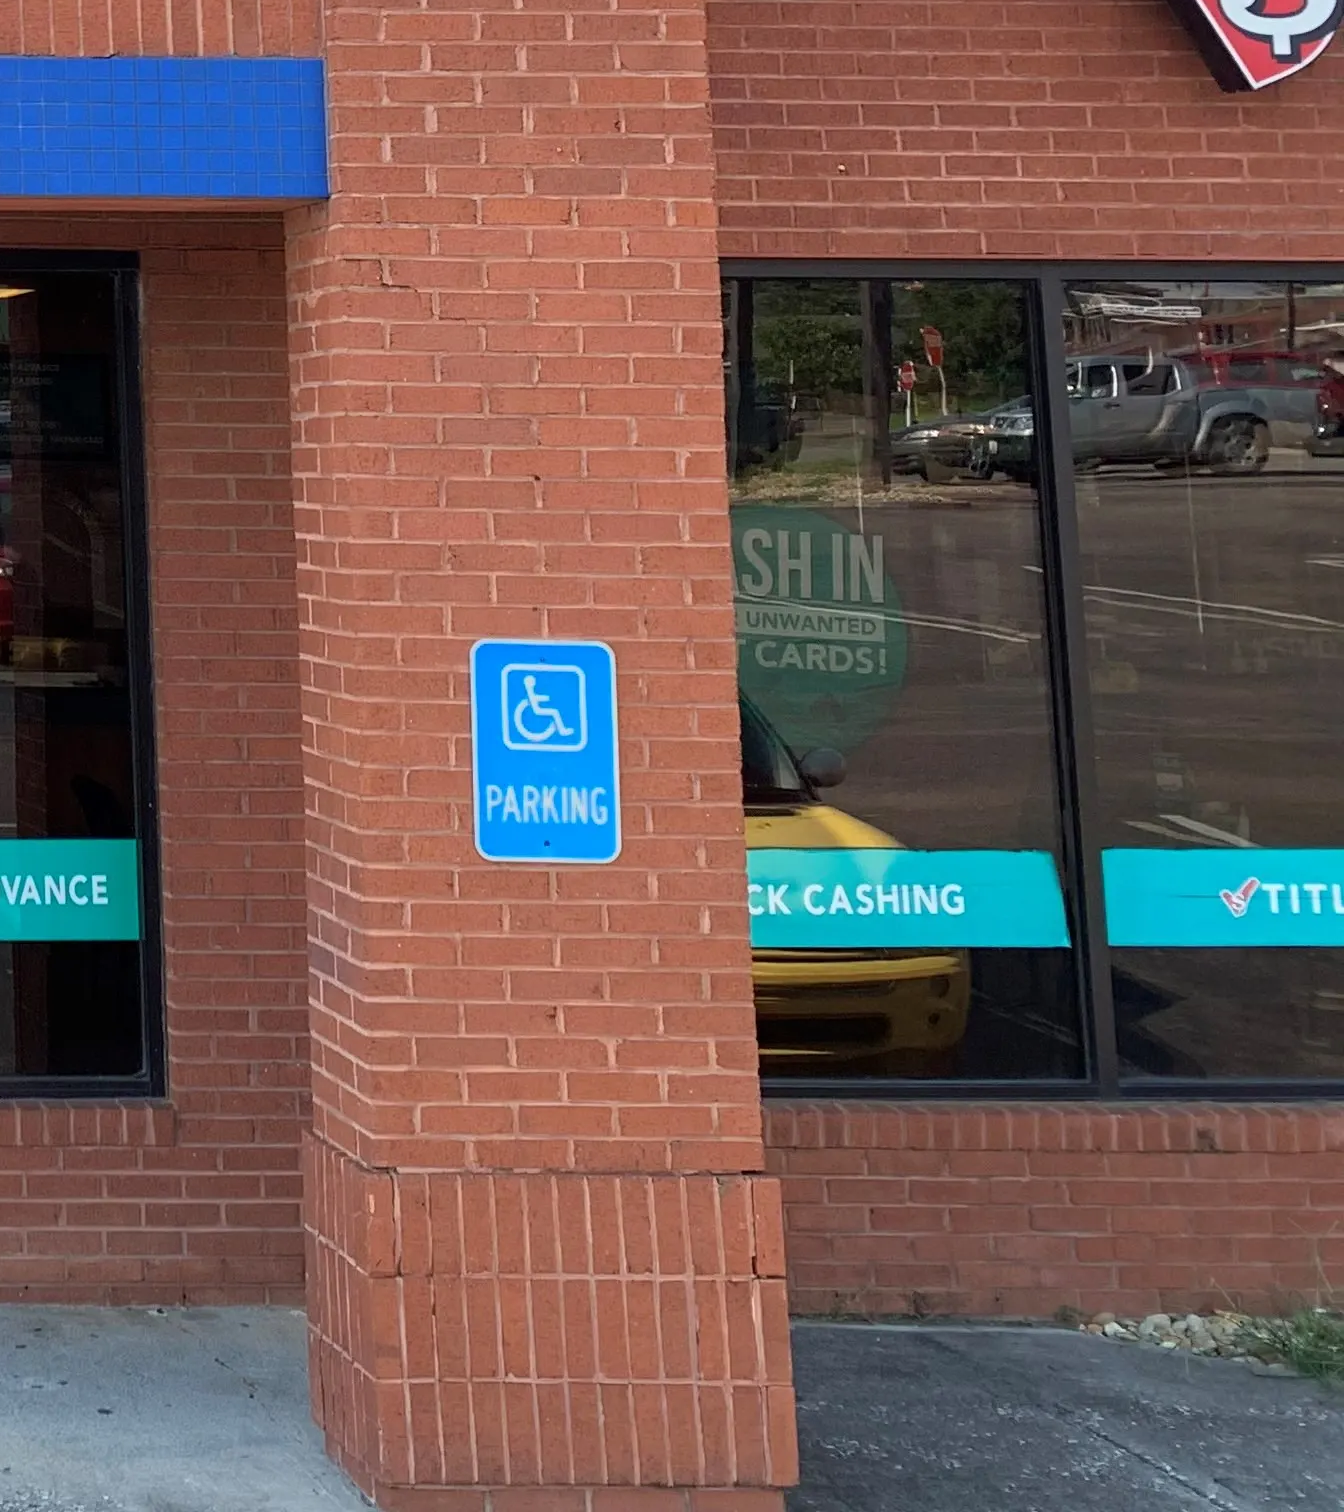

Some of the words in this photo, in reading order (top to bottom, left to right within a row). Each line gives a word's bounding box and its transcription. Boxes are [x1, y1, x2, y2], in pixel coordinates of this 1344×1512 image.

[732, 528, 812, 599] SH
[832, 533, 884, 603] IN
[746, 610, 877, 635] UNWANTED
[754, 640, 887, 675] CARDS!
[486, 784, 608, 825] PARKING
[803, 884, 965, 915] CASHING
